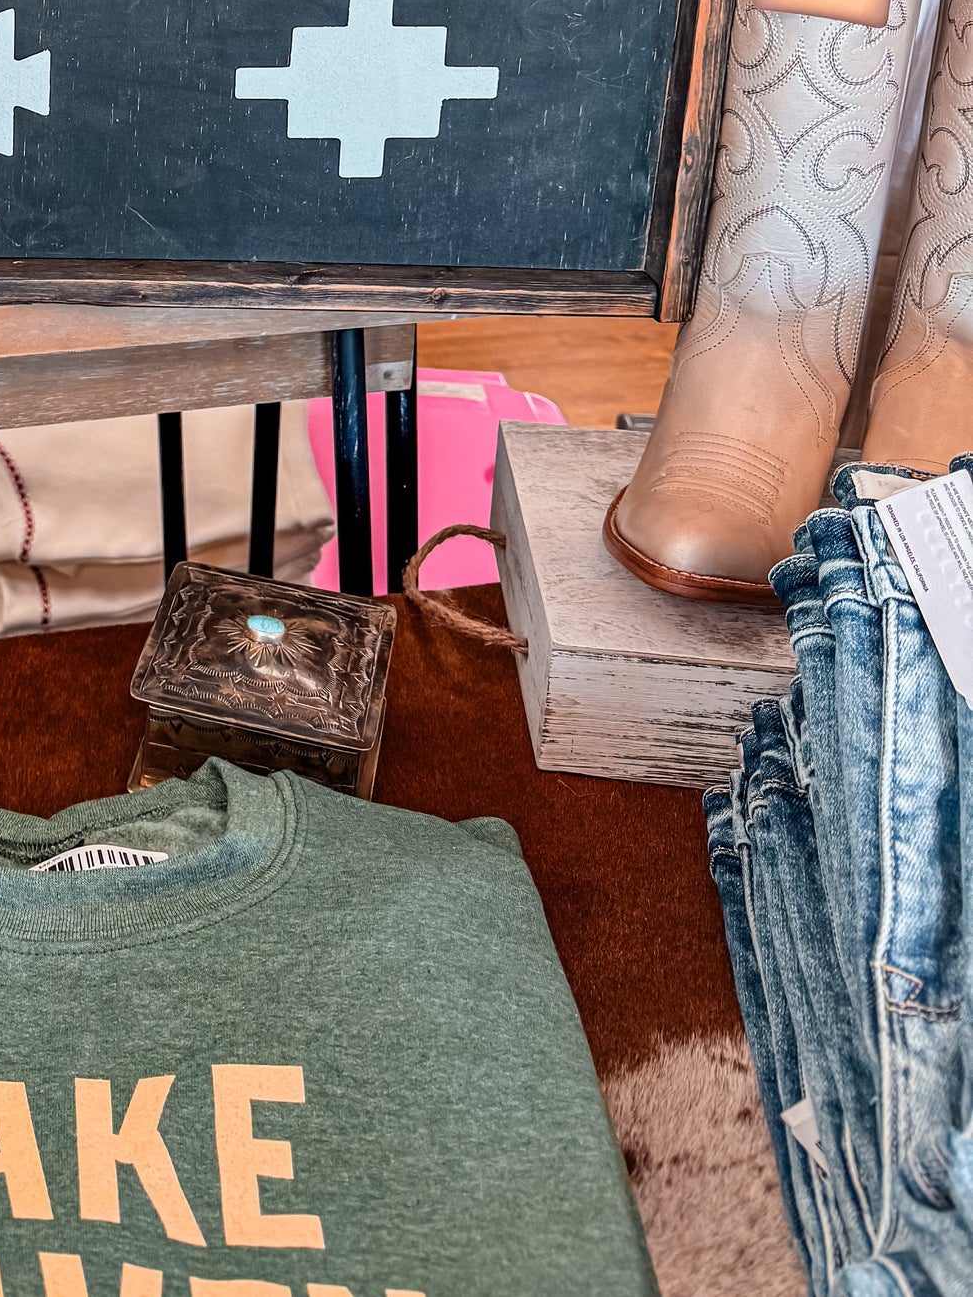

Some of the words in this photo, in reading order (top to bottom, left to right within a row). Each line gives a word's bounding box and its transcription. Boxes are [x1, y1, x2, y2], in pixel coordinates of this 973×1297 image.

[886, 504, 900, 527] DESIGNED
[899, 532, 907, 542] LOS
[913, 564, 929, 592] CALIFORNIA
